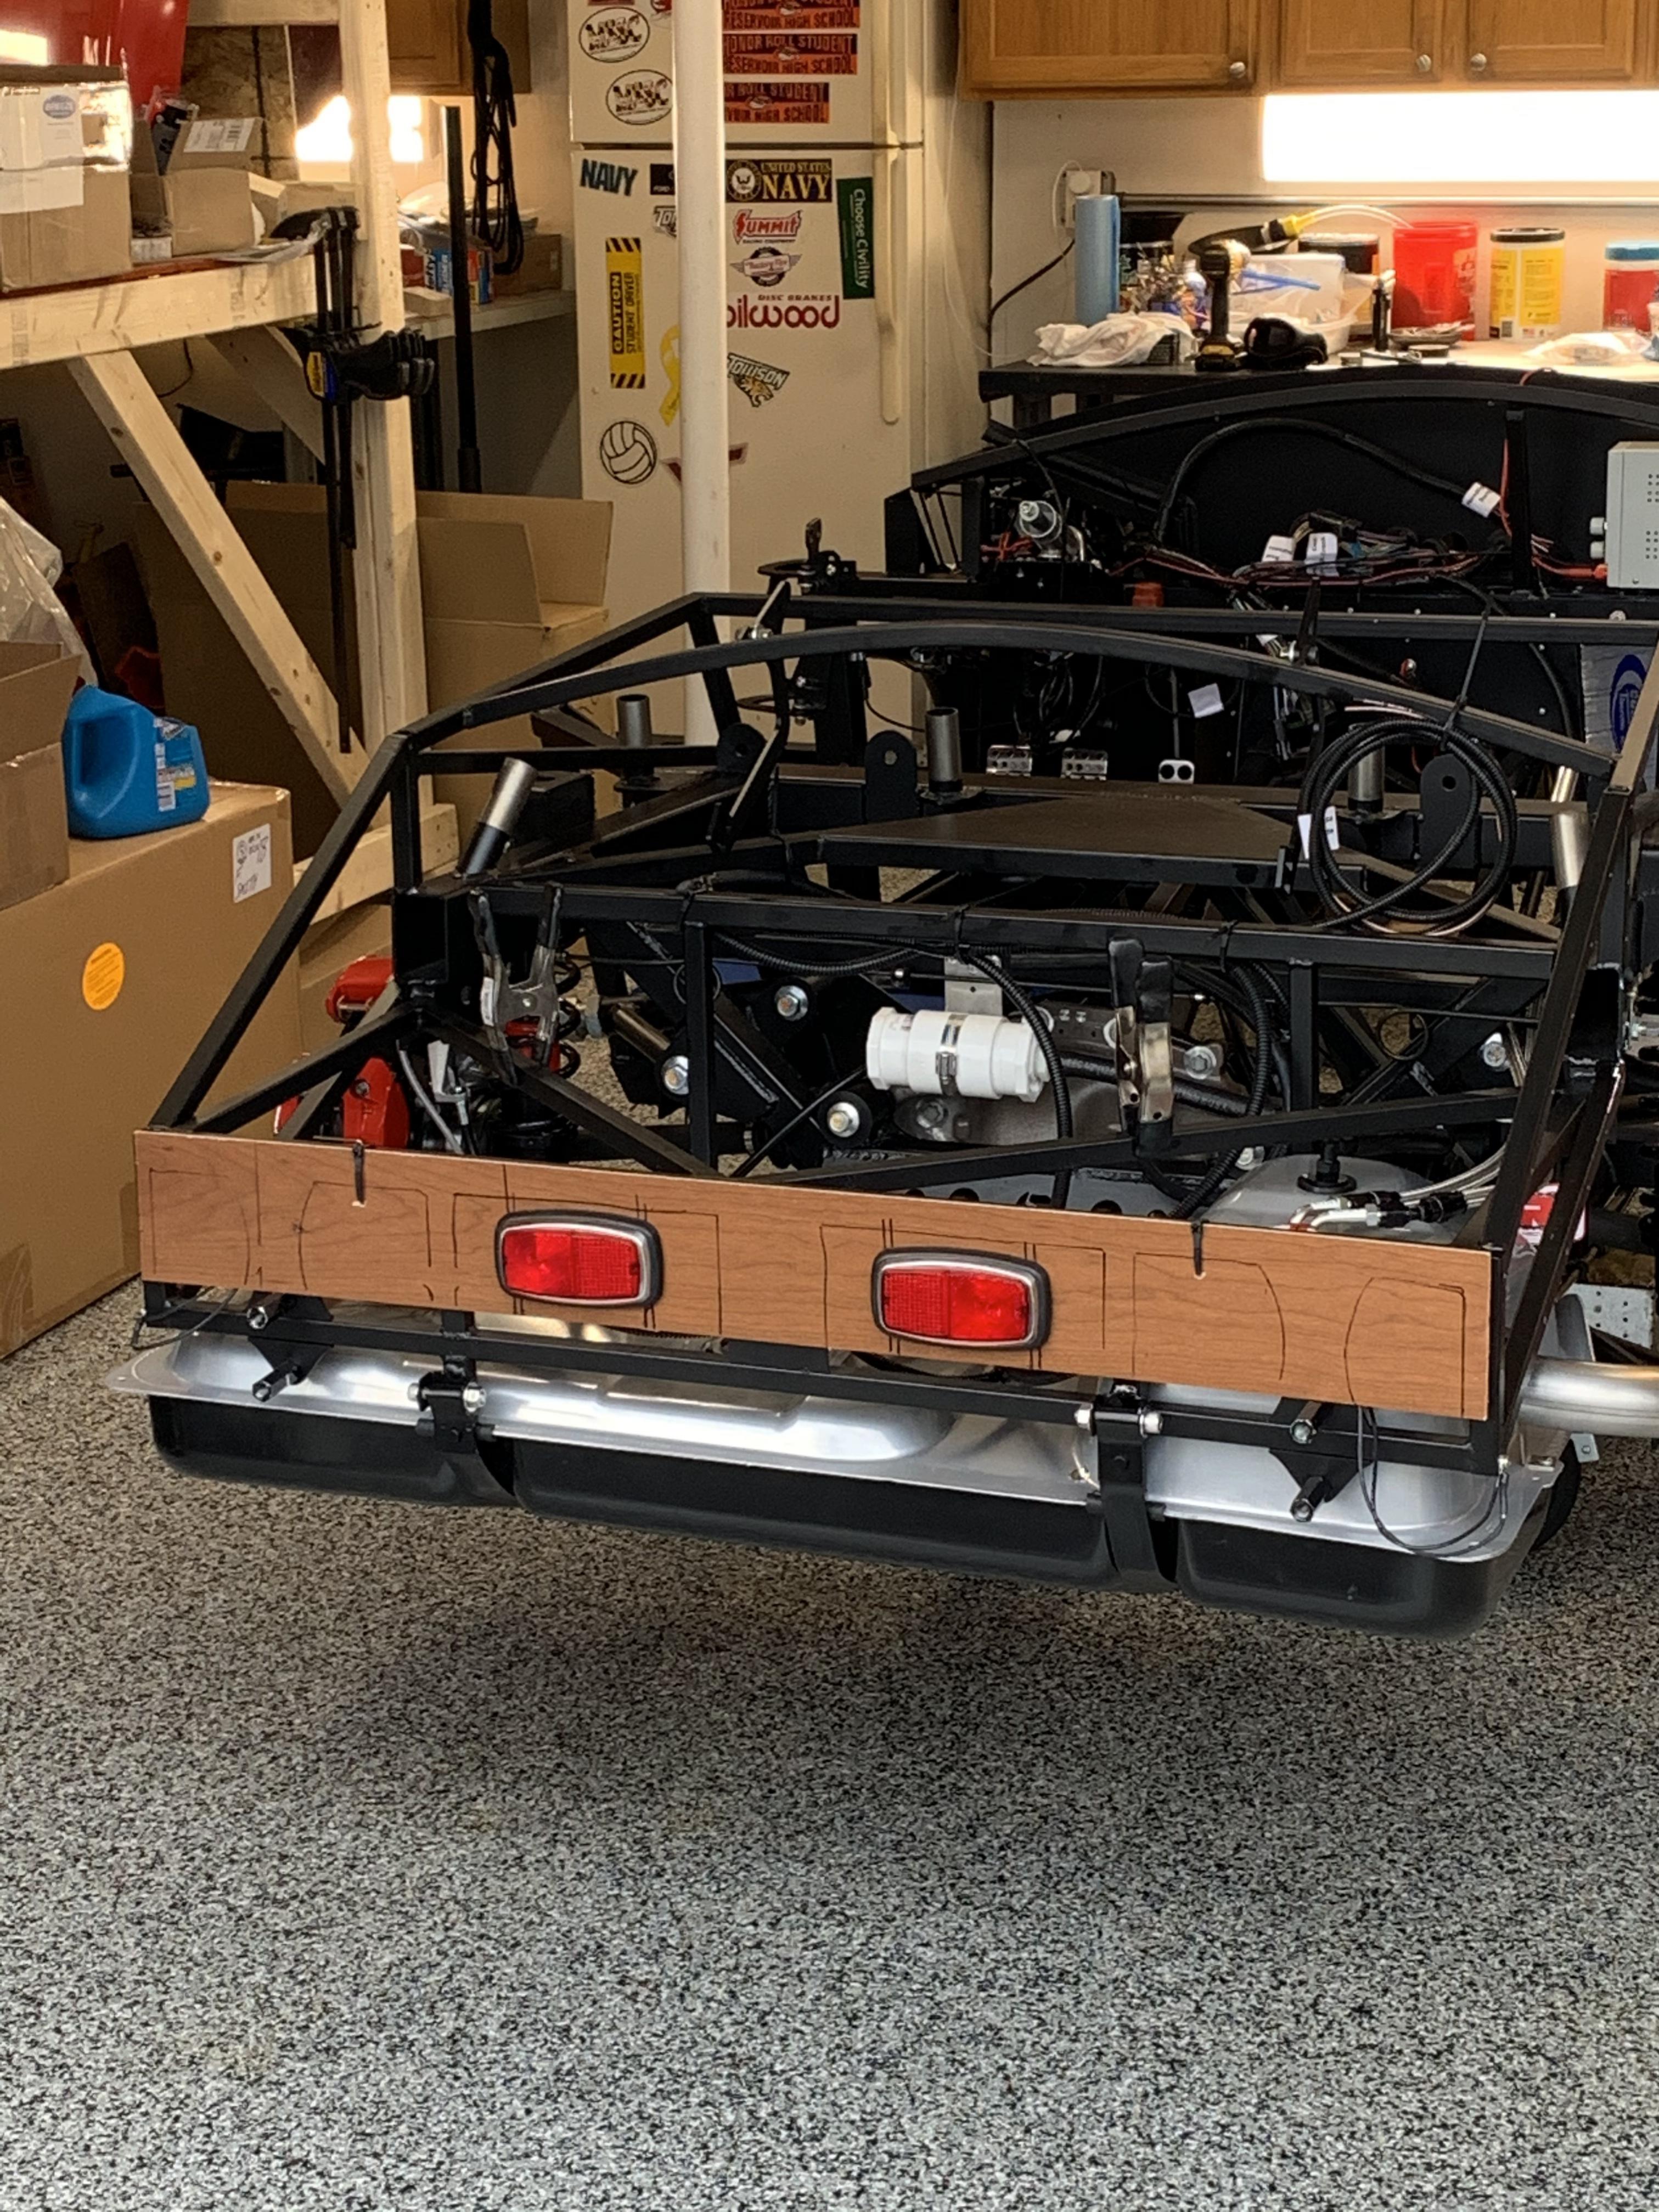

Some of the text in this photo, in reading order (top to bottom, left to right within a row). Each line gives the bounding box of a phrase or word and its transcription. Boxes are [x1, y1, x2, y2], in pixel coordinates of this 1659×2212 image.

[814, 8, 857, 28] SCHOOL
[797, 36, 853, 57] STUDENT
[812, 55, 854, 74] SCHOOL
[771, 82, 824, 102] STUDENT
[784, 104, 828, 122] SCHOOL
[580, 158, 638, 196] NAVY
[761, 162, 831, 173] UNITED STATES
[762, 173, 829, 200] NAVY
[853, 189, 866, 237] Choose
[855, 239, 870, 289] Civility
[612, 275, 622, 351] CAUTION
[626, 310, 636, 353] STUDENT
